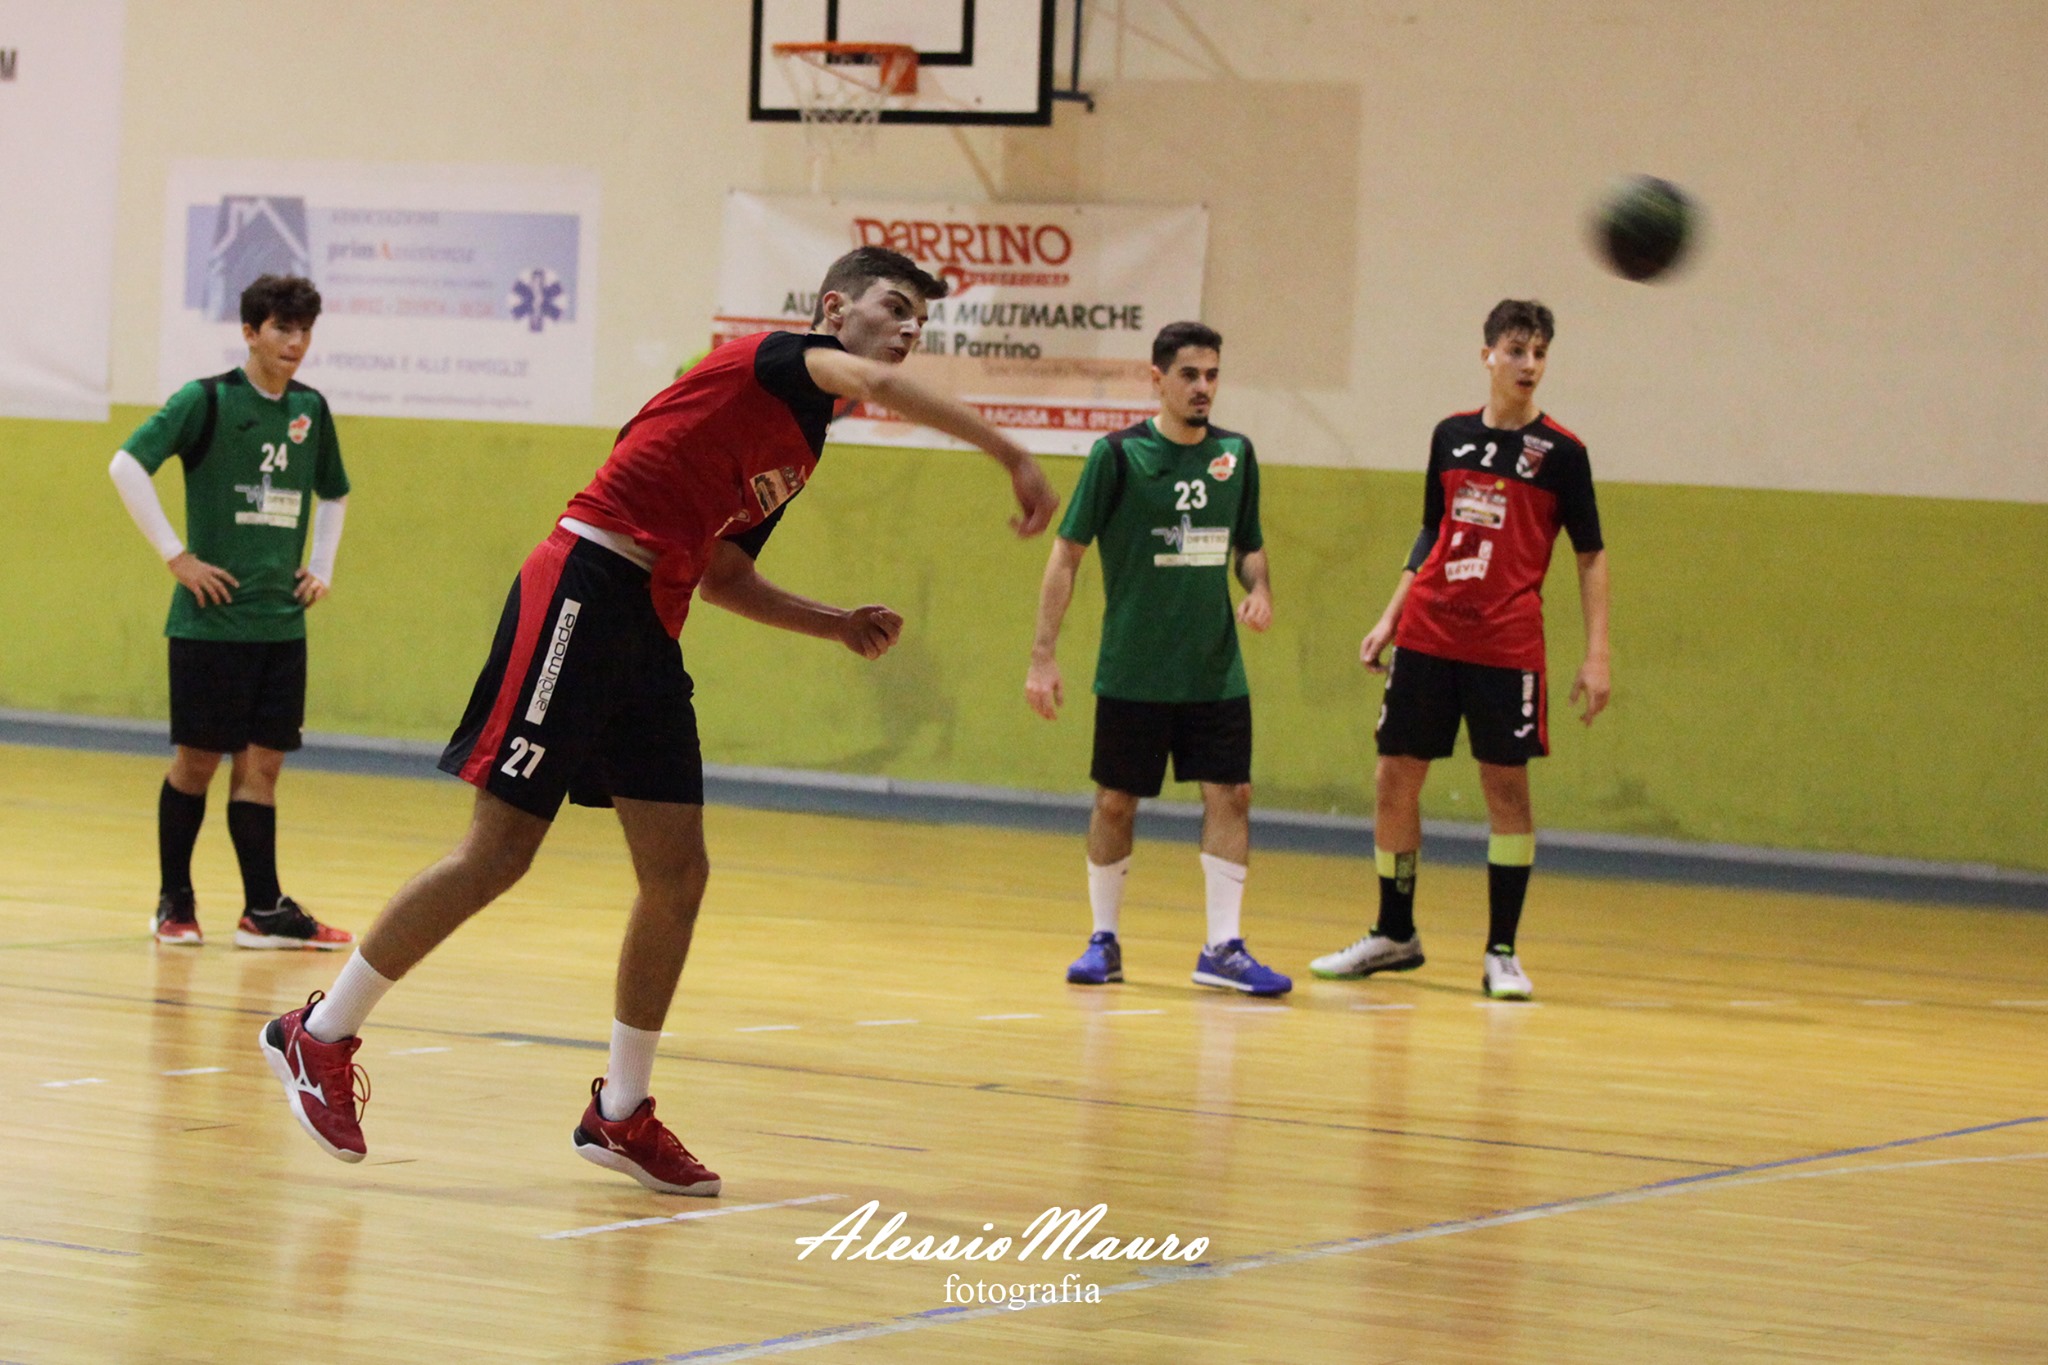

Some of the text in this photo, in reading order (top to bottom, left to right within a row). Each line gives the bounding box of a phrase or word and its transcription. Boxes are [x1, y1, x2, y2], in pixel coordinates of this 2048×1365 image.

[955, 302, 1142, 331] MULTIMARCHE
[954, 333, 1041, 359] Parrino
[259, 443, 288, 472] 24
[1480, 441, 1498, 467] 2
[1174, 479, 1208, 511] 23
[535, 613, 576, 711] andimoda
[500, 736, 546, 779] 27
